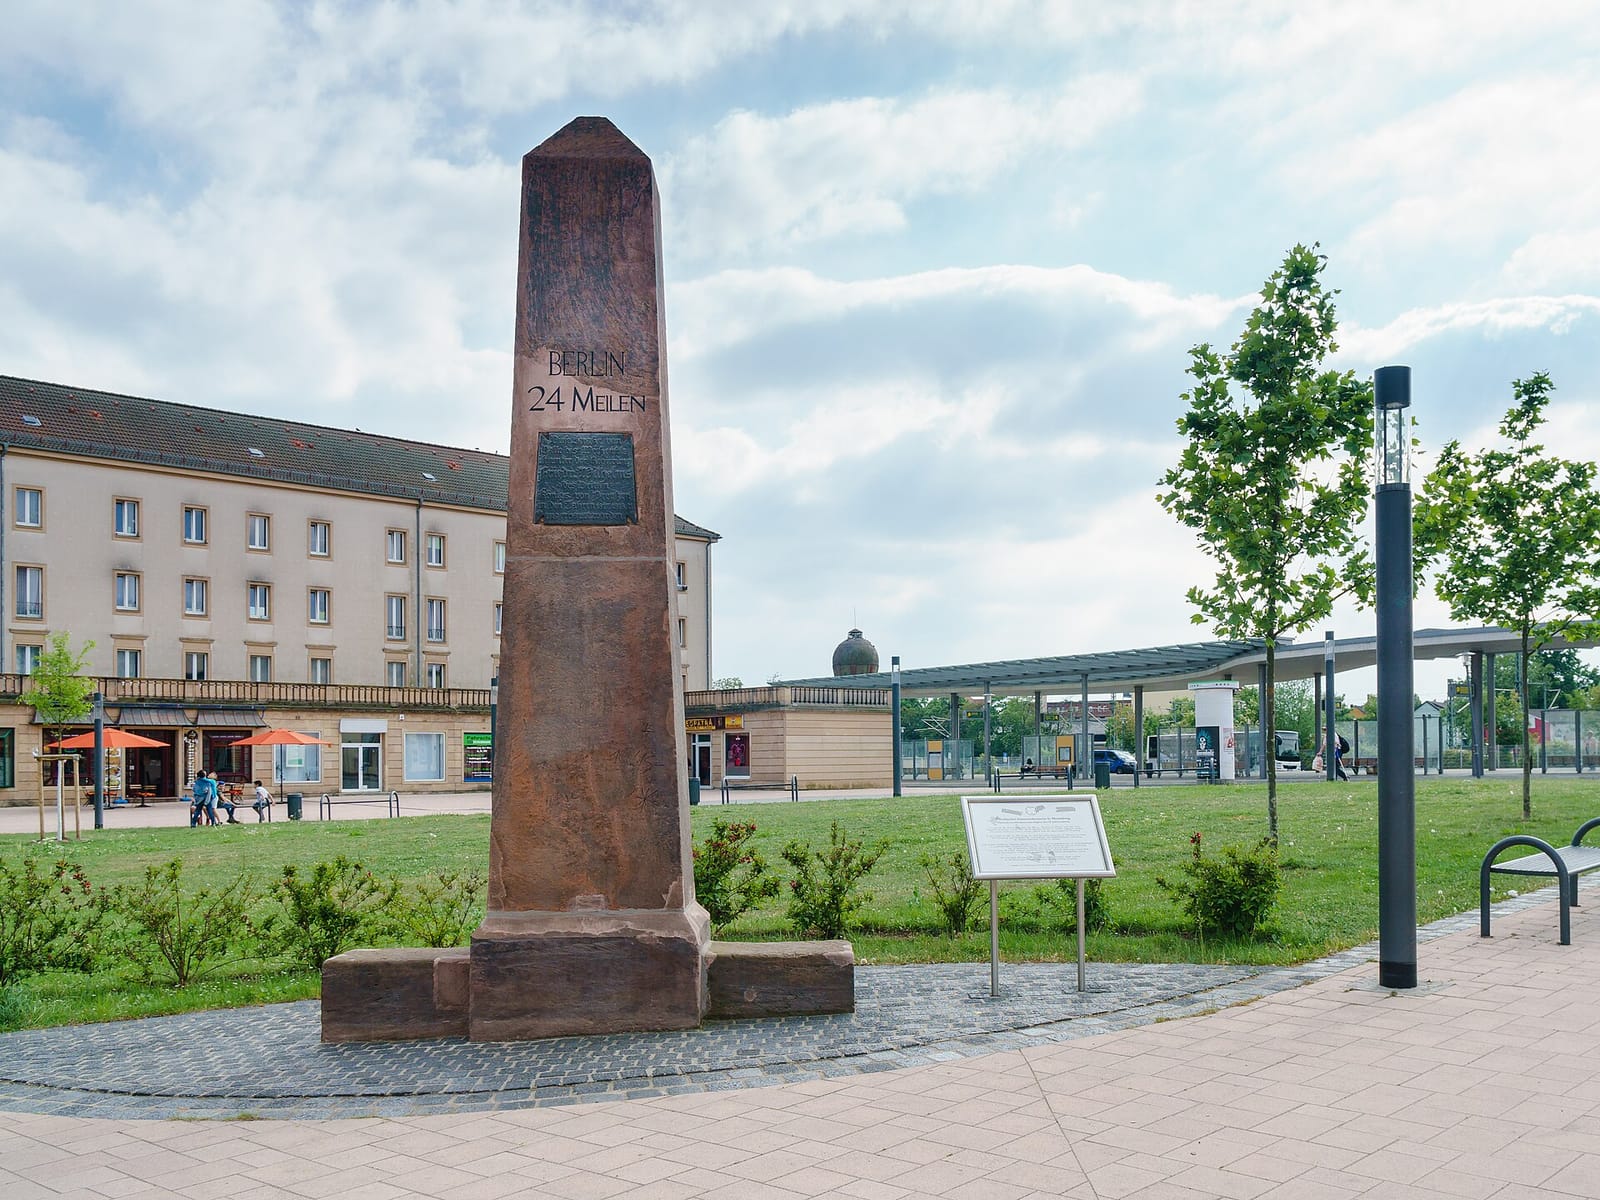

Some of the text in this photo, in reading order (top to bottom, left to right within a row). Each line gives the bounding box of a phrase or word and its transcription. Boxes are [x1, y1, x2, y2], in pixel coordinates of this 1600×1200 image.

[549, 350, 625, 377] BERLIN
[527, 385, 646, 413] 24 MEILEN
